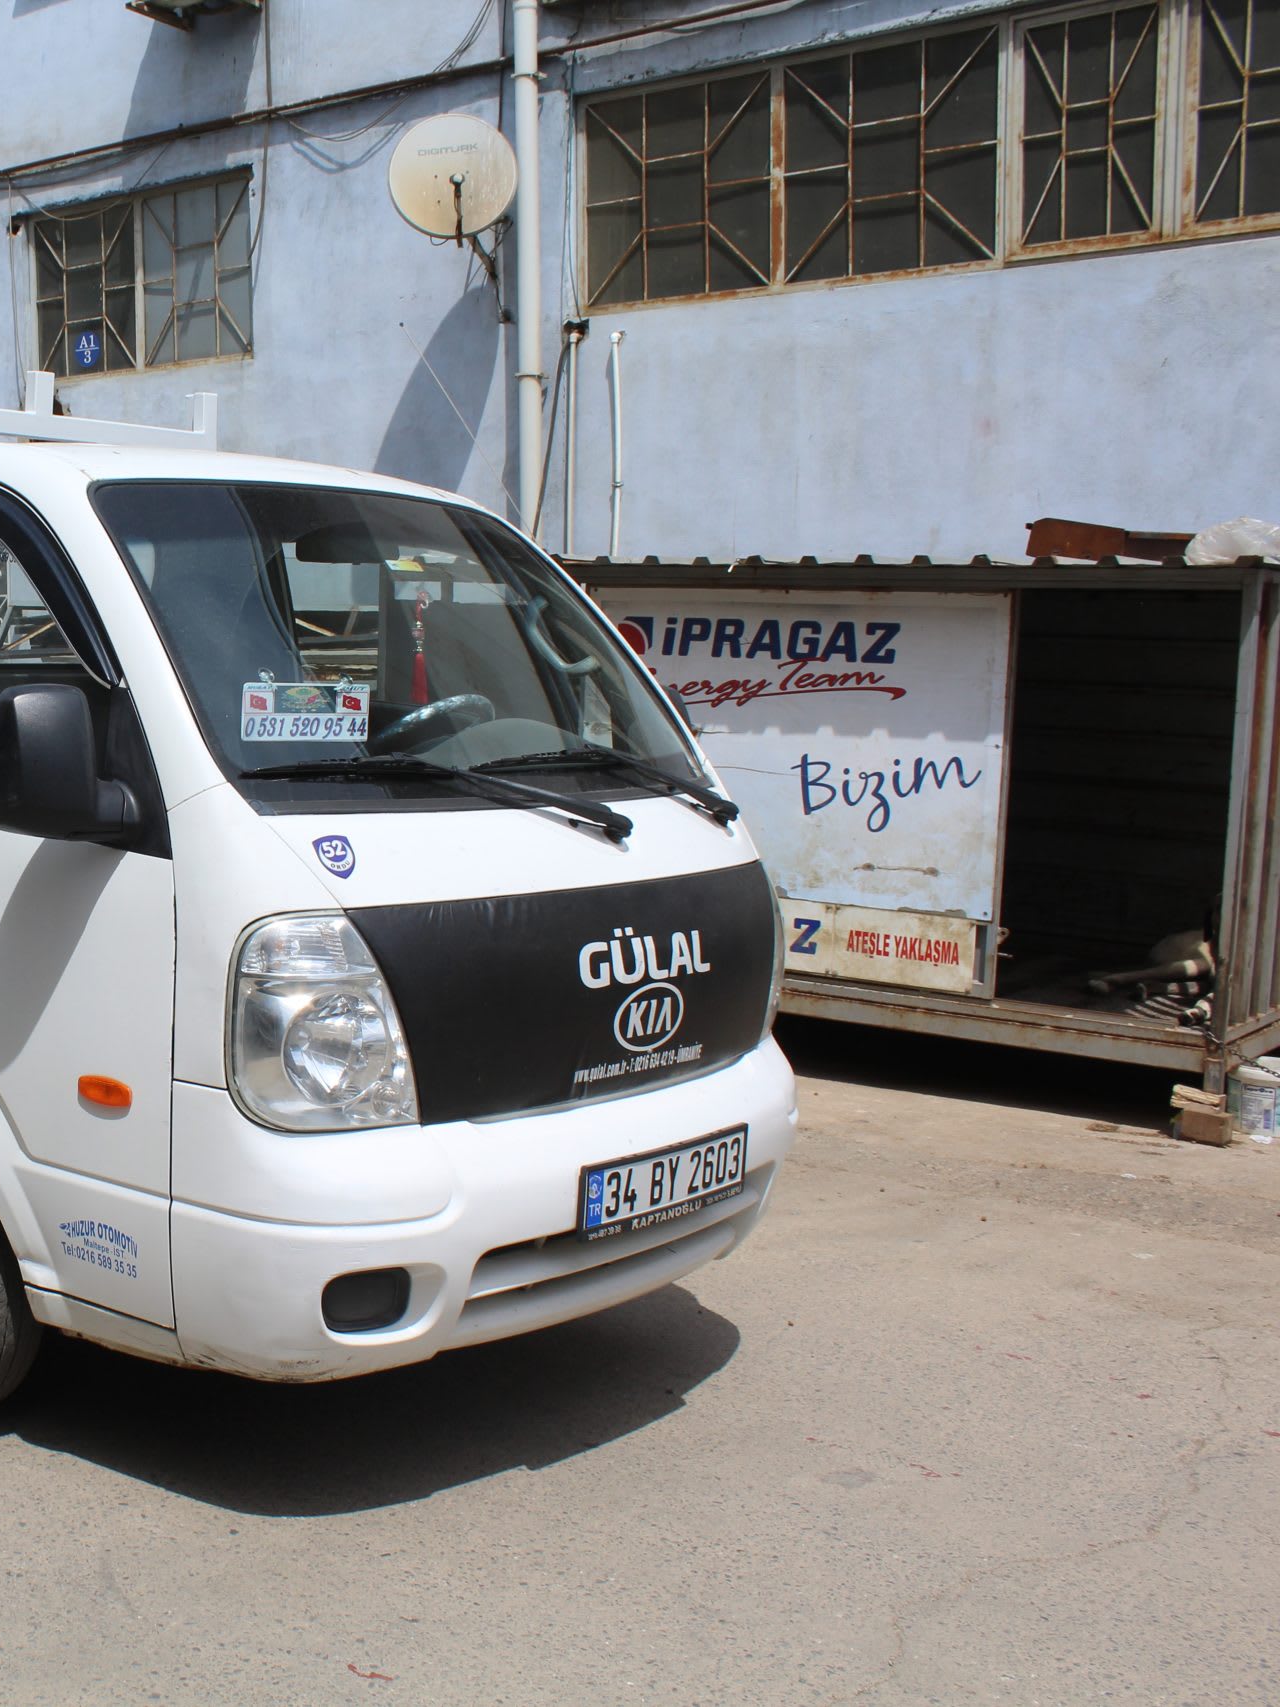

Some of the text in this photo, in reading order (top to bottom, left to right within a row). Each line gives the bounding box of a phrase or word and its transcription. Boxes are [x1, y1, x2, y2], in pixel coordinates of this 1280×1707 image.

[417, 143, 478, 156] DIGITURK
[79, 334, 96, 349] A1
[83, 350, 92, 364] 3
[776, 657, 886, 691] Team
[245, 715, 368, 739] 0 531 520 95 44
[791, 753, 982, 833] Bizim
[321, 839, 347, 859] 52
[578, 926, 711, 990] GÜLAL
[847, 929, 960, 967] ATEŞLE YAKLAŞMA
[626, 996, 672, 1039] KIA
[605, 1168, 637, 1218] 34
[650, 1156, 680, 1206] BY
[687, 1137, 741, 1195] 2603
[589, 1202, 601, 1217] TR
[97, 1222, 138, 1259] OTOMOTİV
[97, 1253, 112, 1270] 589
[114, 1259, 125, 1274] 35
[126, 1263, 137, 1278] 35
